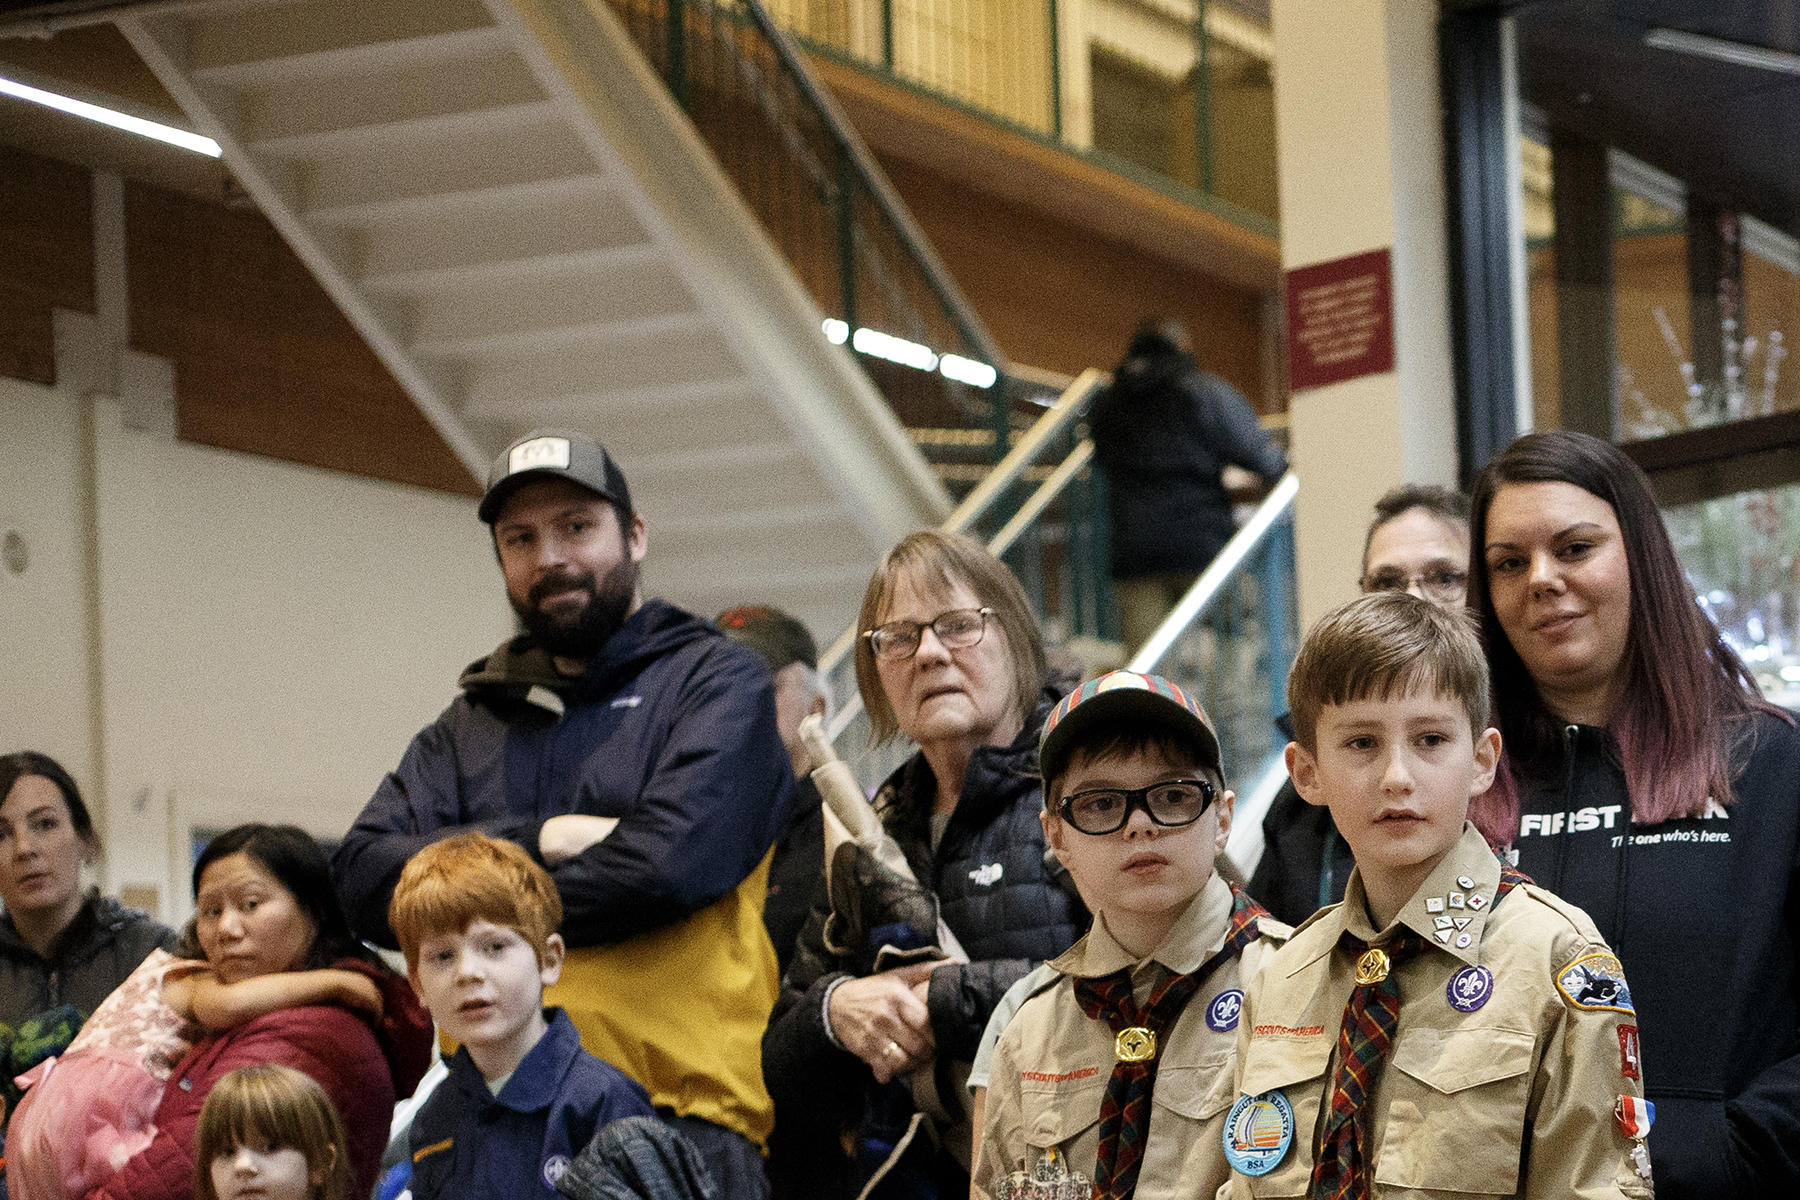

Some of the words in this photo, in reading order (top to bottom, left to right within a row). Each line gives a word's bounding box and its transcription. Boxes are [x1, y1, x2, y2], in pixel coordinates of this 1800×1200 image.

[1520, 805, 1621, 837] FIRST
[1635, 834, 1661, 845] one
[1662, 829, 1699, 843] who's
[1700, 830, 1731, 843] here.
[1626, 1032, 1637, 1070] 4
[1269, 1095, 1289, 1139] REGATTA
[1247, 1160, 1265, 1170] BSA
